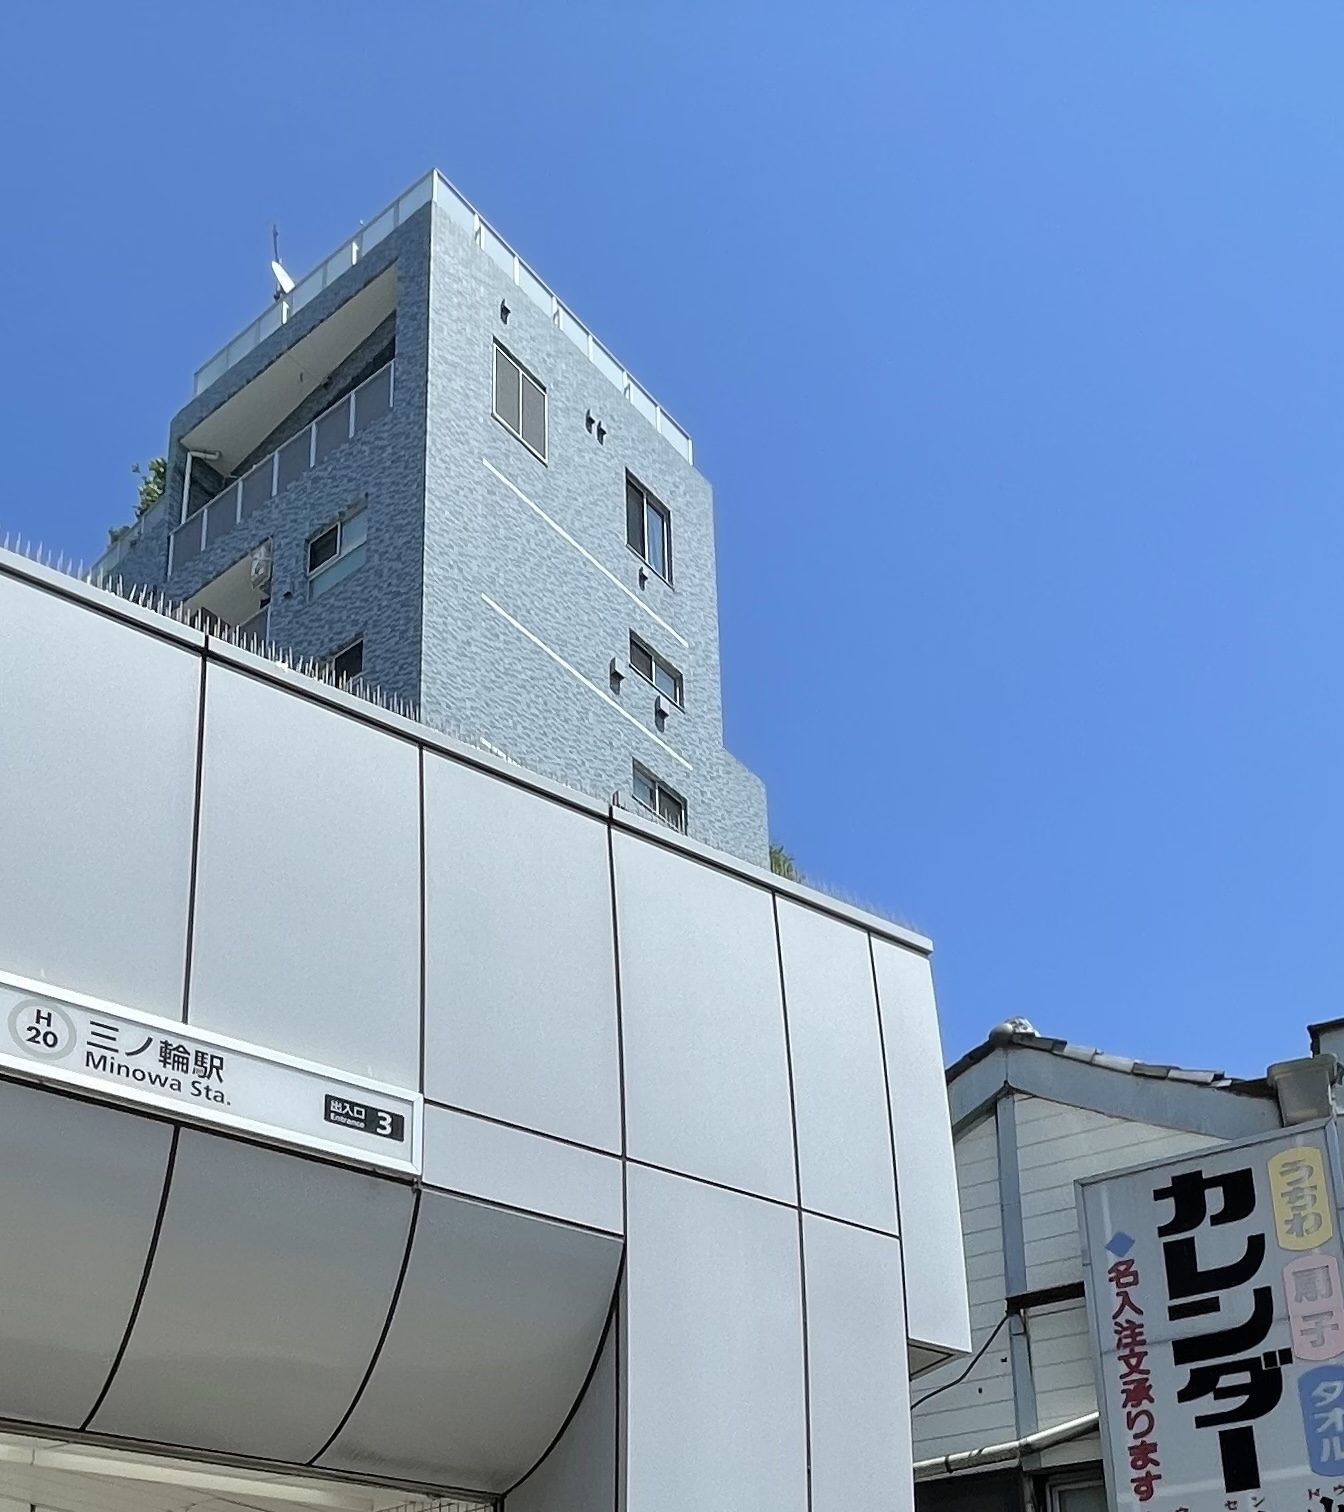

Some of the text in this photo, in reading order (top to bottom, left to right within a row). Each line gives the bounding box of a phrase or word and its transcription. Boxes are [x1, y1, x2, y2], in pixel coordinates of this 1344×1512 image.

[25, 1025, 59, 1049] 20
[35, 1008, 53, 1028] H
[86, 1020, 225, 1084] 三ノ輪駅
[85, 1051, 232, 1106] Minowa Sta.
[330, 1099, 366, 1120] 出入口
[330, 1112, 366, 1129] Entrance
[376, 1111, 392, 1135] 3
[1279, 1158, 1323, 1239] うちわ
[1153, 1167, 1293, 1494] カレンダー
[1107, 1258, 1162, 1502] 名入注文承ります
